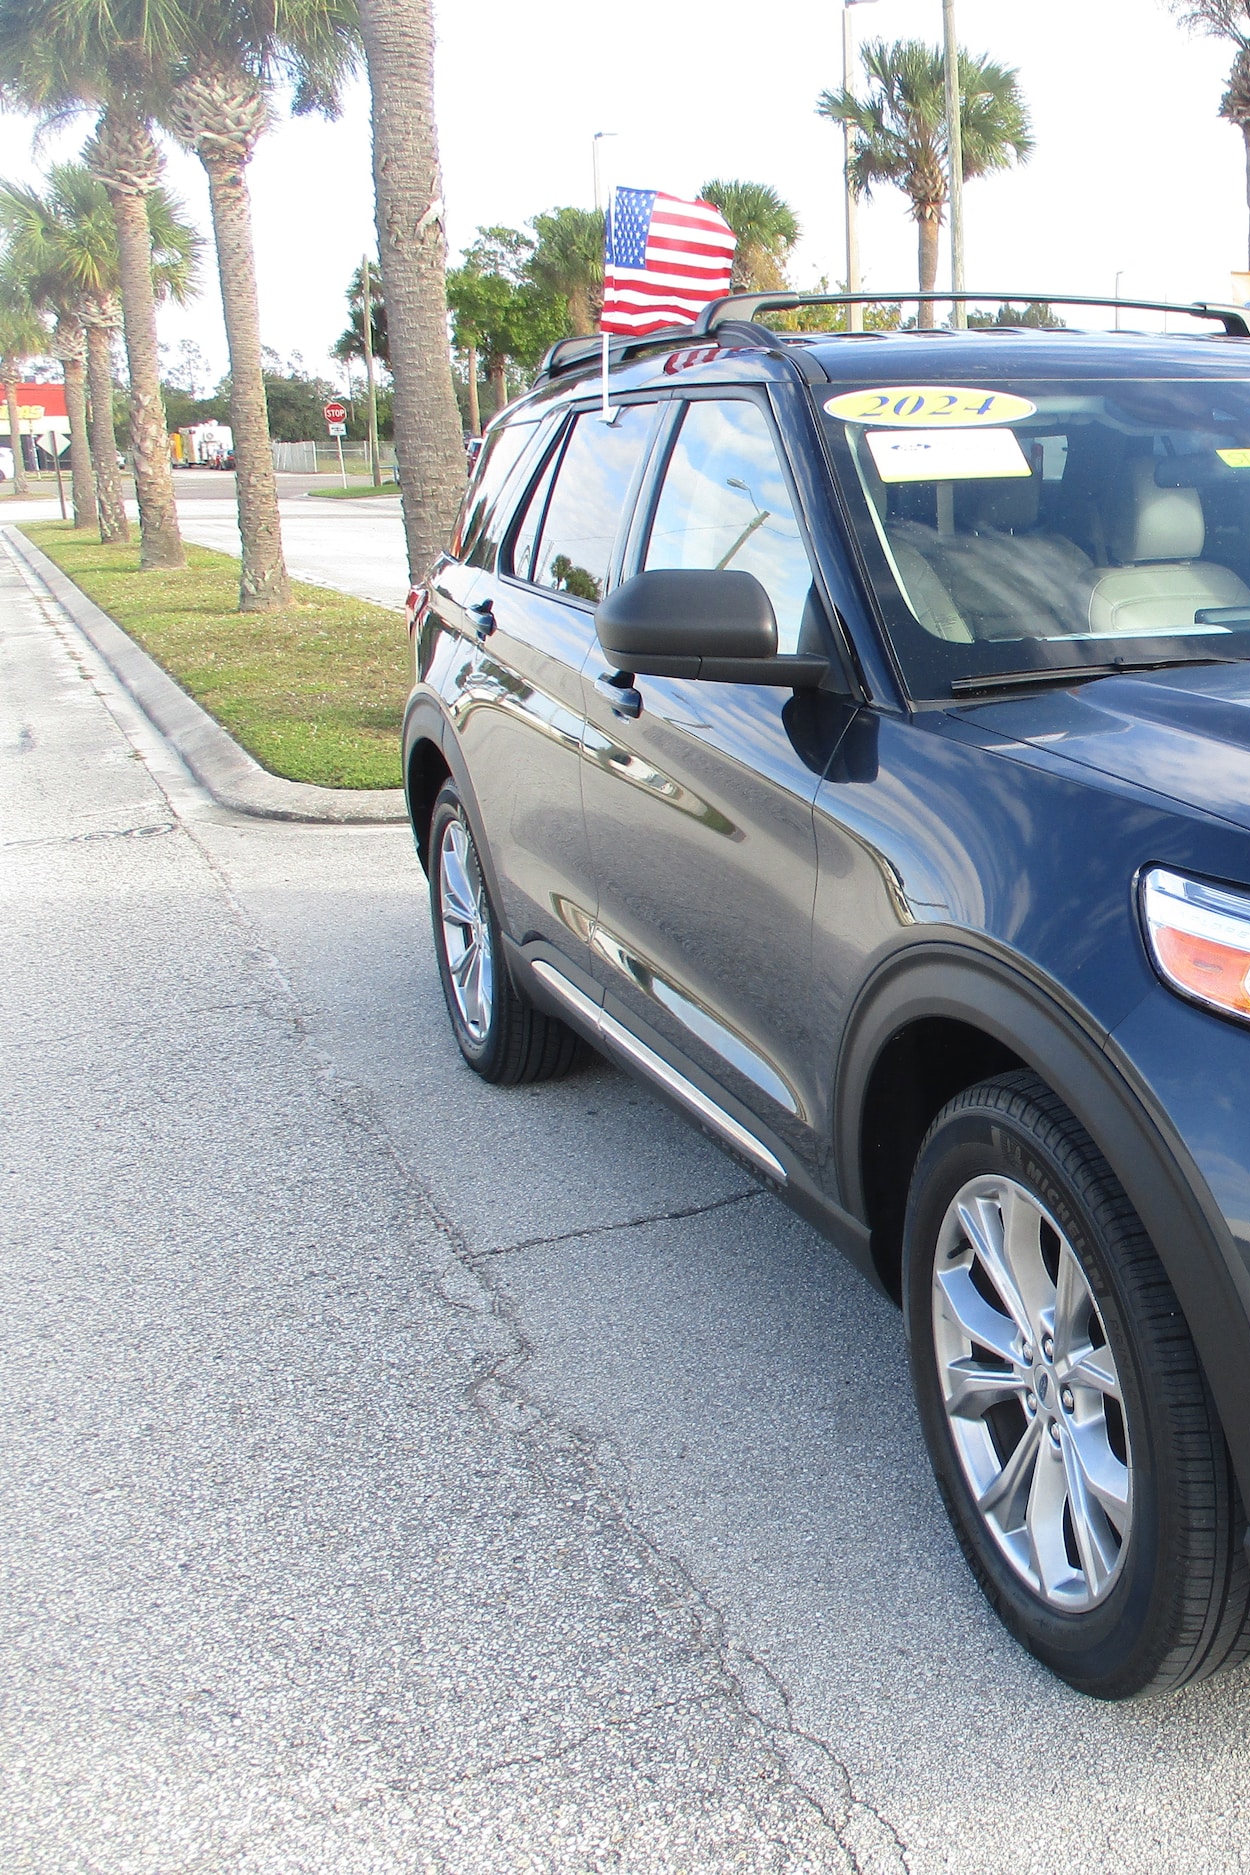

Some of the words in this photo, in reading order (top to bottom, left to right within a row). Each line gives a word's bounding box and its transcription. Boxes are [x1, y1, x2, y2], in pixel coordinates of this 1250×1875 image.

[326, 409, 345, 418] STOP
[858, 395, 996, 417] 2024
[1026, 1161, 1105, 1290] MICHELIN
